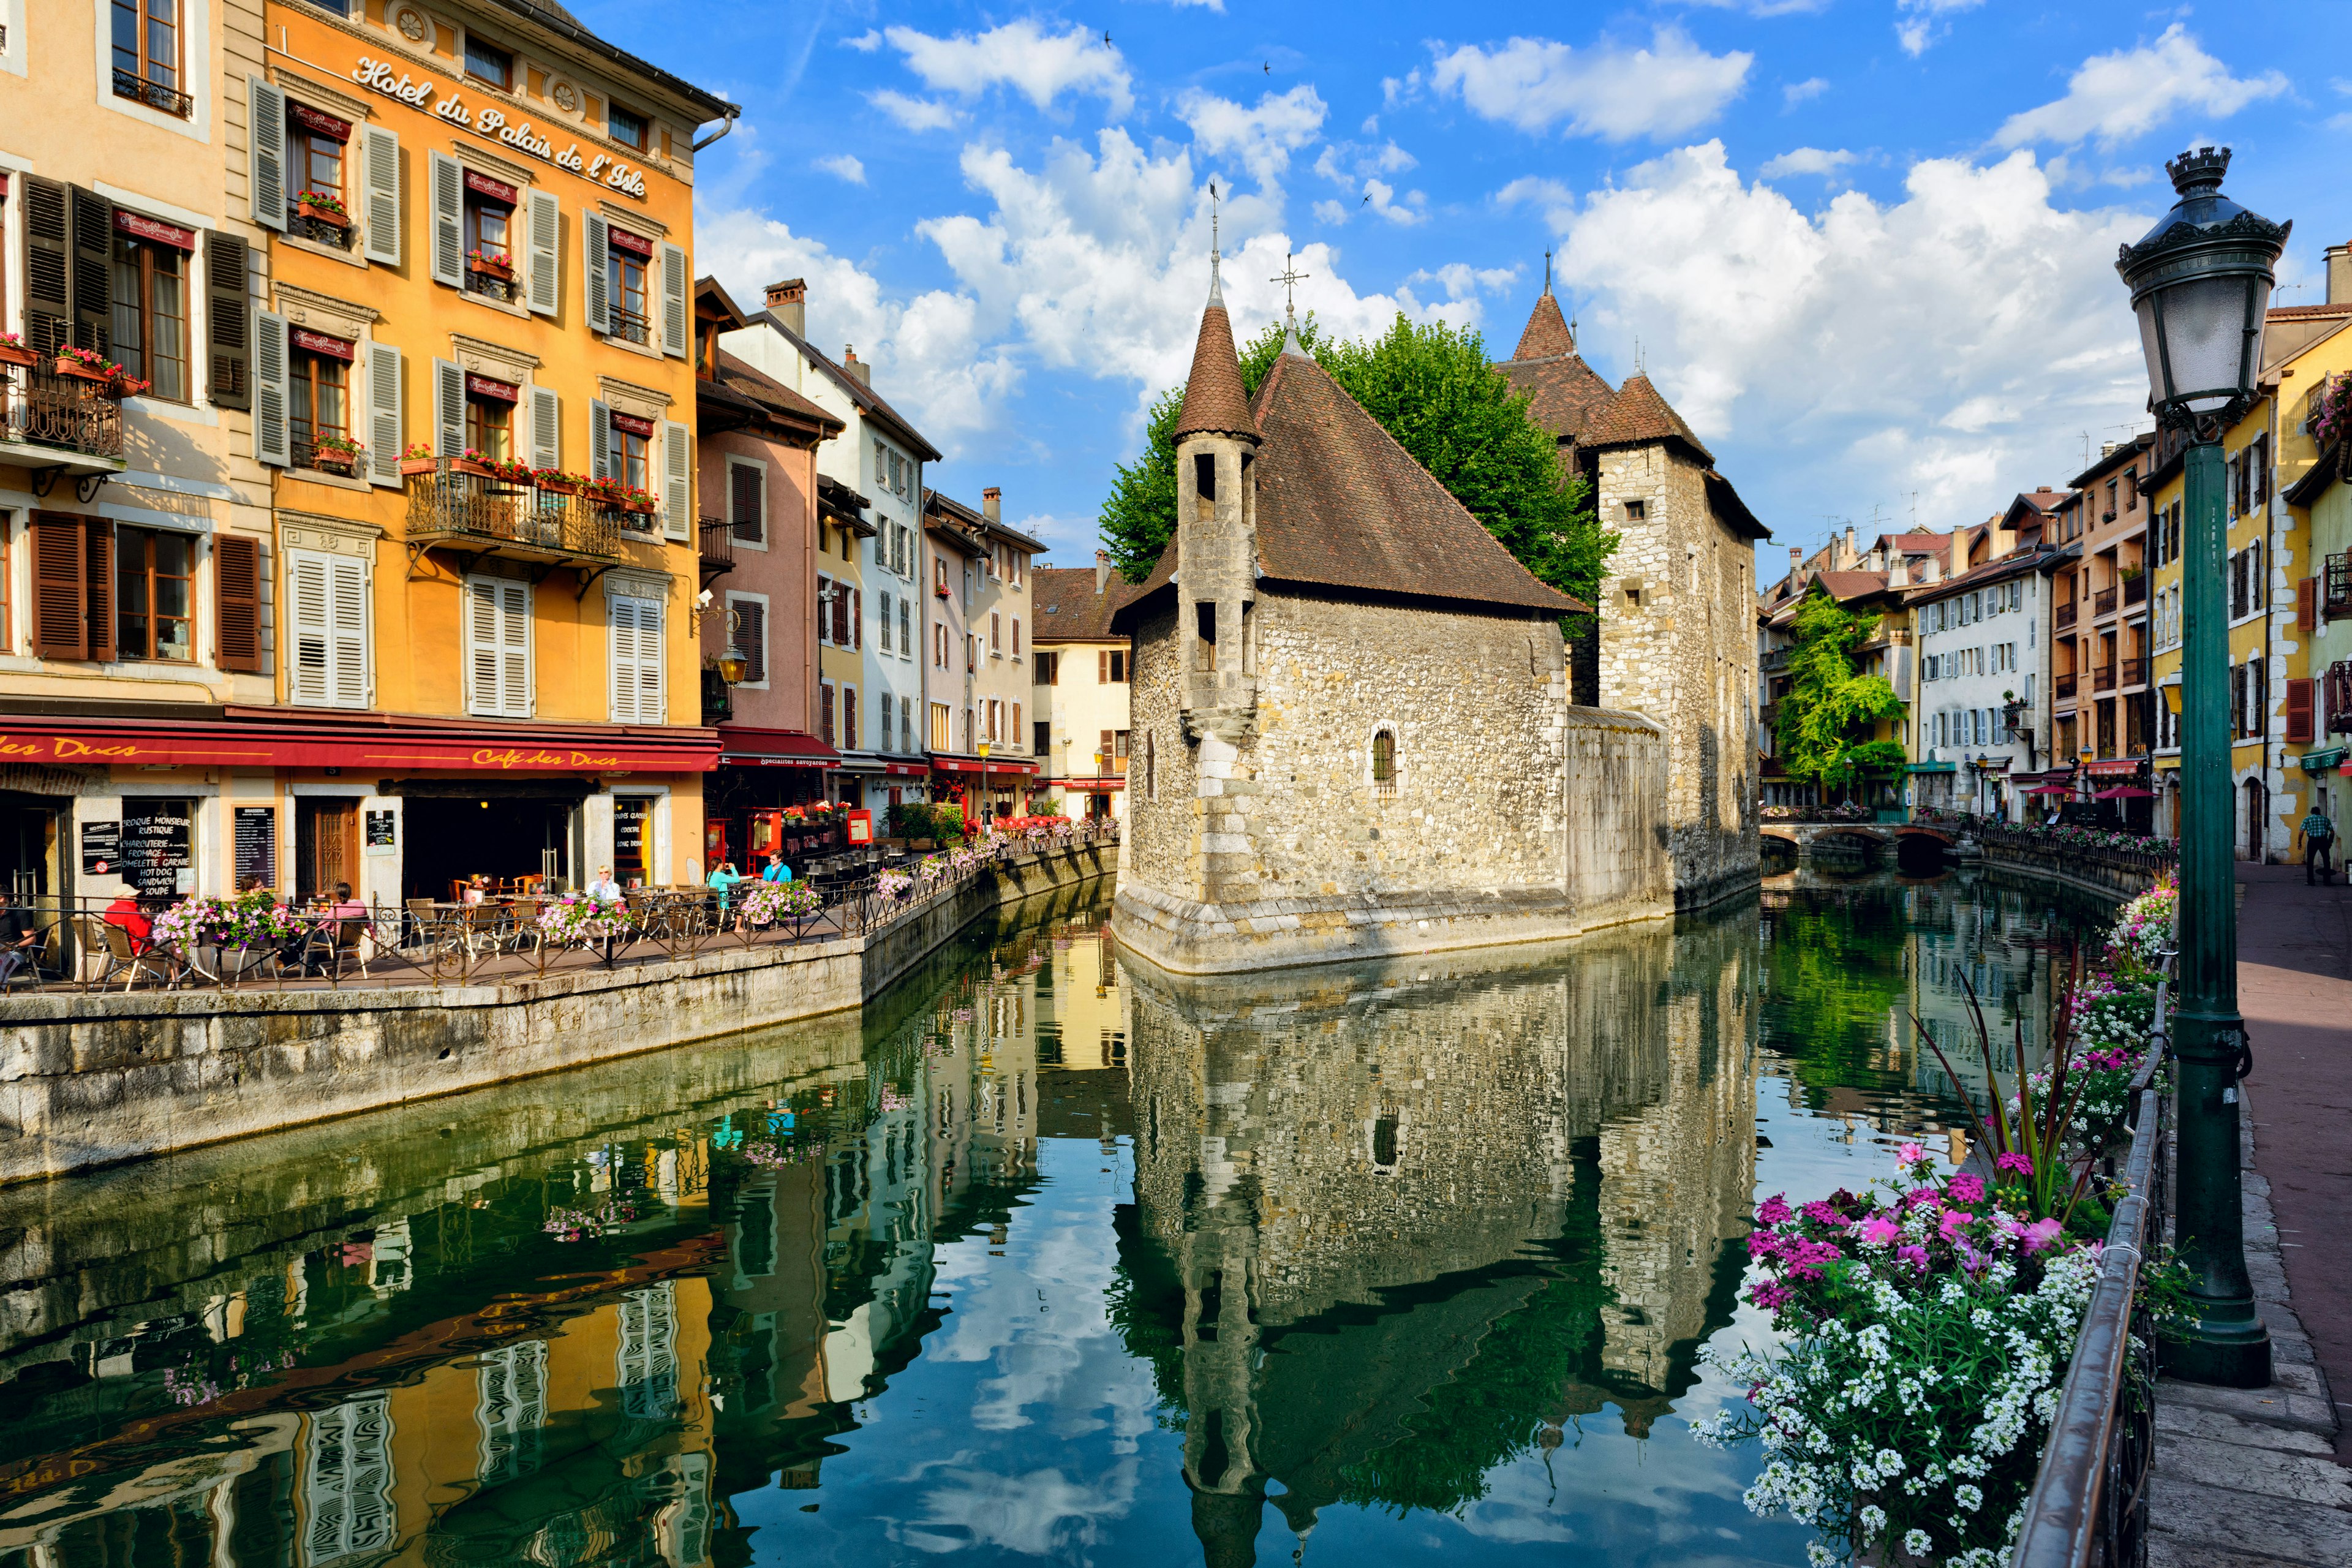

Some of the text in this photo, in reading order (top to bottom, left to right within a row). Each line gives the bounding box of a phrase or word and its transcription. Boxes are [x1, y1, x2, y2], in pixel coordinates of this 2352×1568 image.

[352, 57, 432, 106] Hotel
[436, 94, 471, 124] du
[477, 109, 551, 158] Palais
[556, 144, 582, 171] de
[54, 737, 138, 757] Ducs
[472, 749, 619, 769] Café des Ducs
[122, 816, 191, 827] CROQUE MONSIEUR
[138, 826, 174, 835] RUSTIQUE
[128, 849, 162, 858] FROMAGE
[122, 858, 190, 867] OMELETTE GARNIE
[137, 877, 175, 886] SANDWICH
[145, 886, 169, 895] SOUPE
